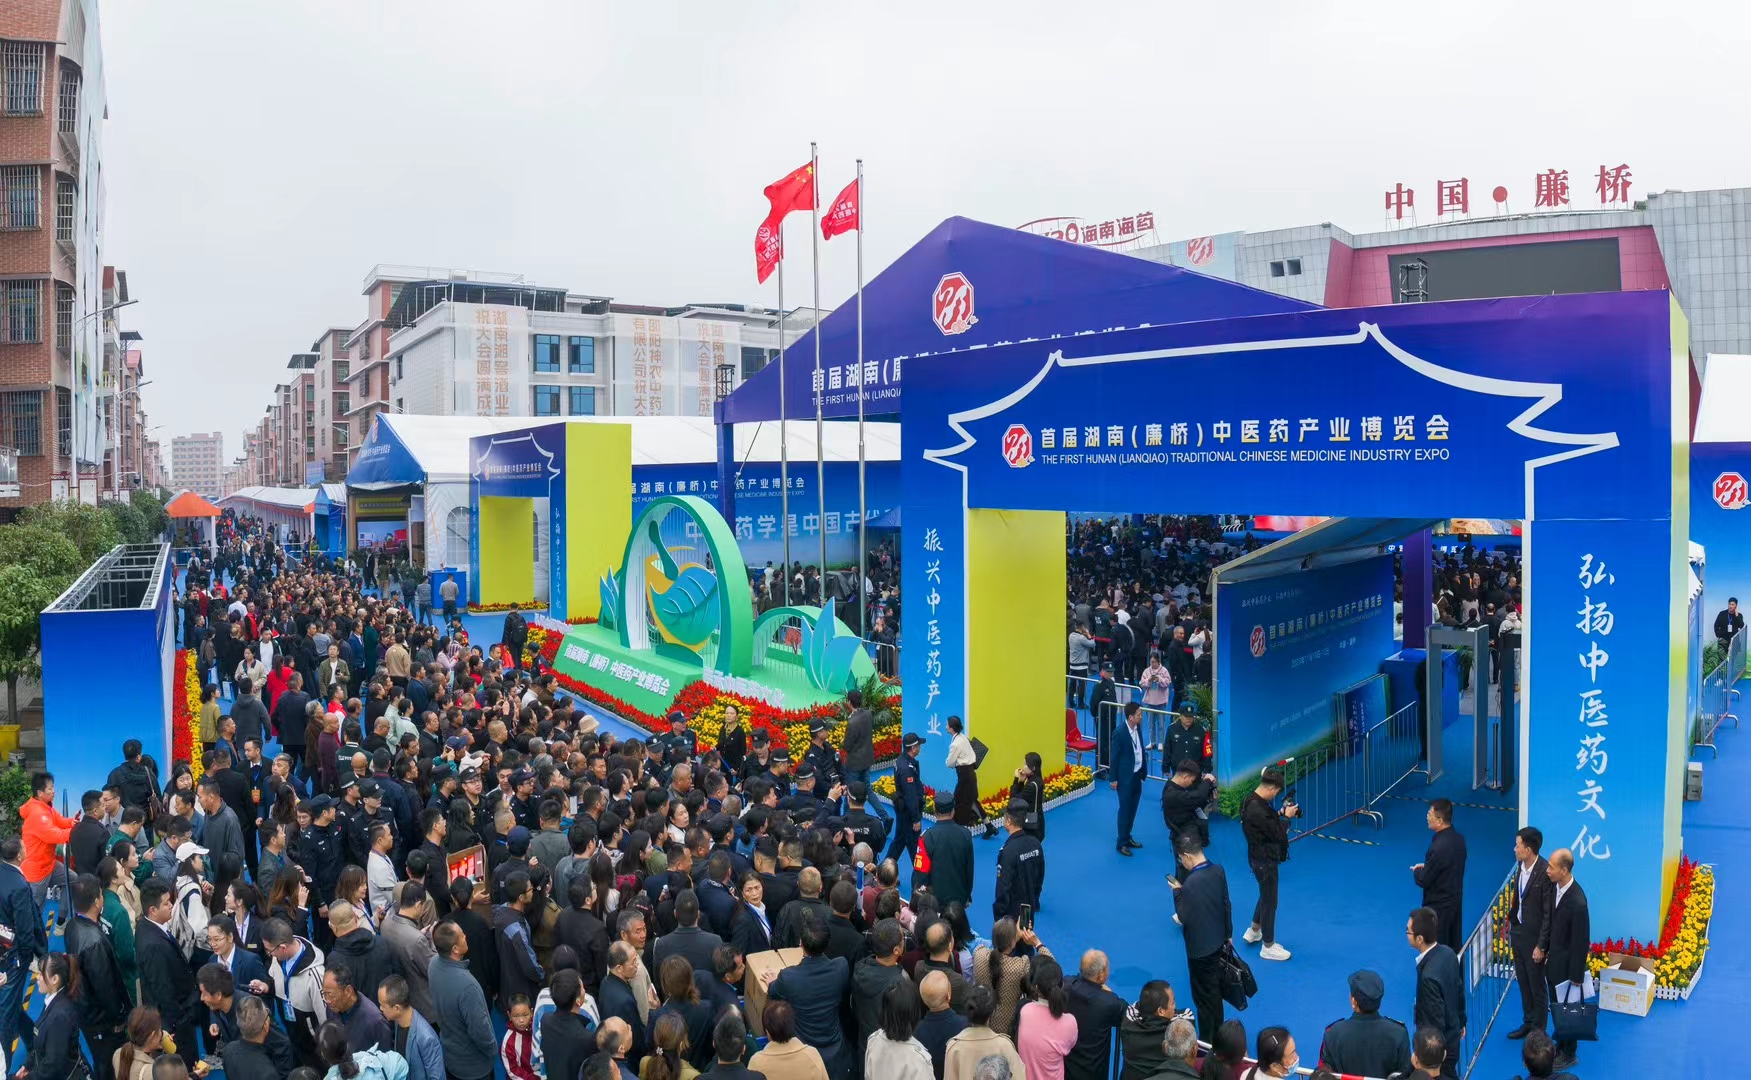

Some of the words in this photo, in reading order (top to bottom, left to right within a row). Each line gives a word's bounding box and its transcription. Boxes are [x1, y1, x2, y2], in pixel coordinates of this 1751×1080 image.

[1080, 211, 1154, 243] 海南海药
[476, 310, 491, 416] 祝大会圆满成
[826, 394, 844, 404] FIRST
[1041, 414, 1450, 449] 首届湖南（廉桥）中医药产业博览会
[1042, 455, 1058, 464] THE
[1060, 454, 1084, 464] FIRST
[1085, 453, 1116, 464] HUNAN
[1118, 452, 1169, 466] (LIANQIAO)
[1171, 451, 1237, 463] TRADITIONAL
[1239, 450, 1287, 462] CHINESE
[1290, 449, 1346, 462] MEDICINE
[1350, 448, 1412, 461] INDUSTRY
[1414, 448, 1450, 461] EXPO
[923, 528, 944, 736] 振兴中医药产业
[1571, 553, 1616, 861] 弘扬中医药文化
